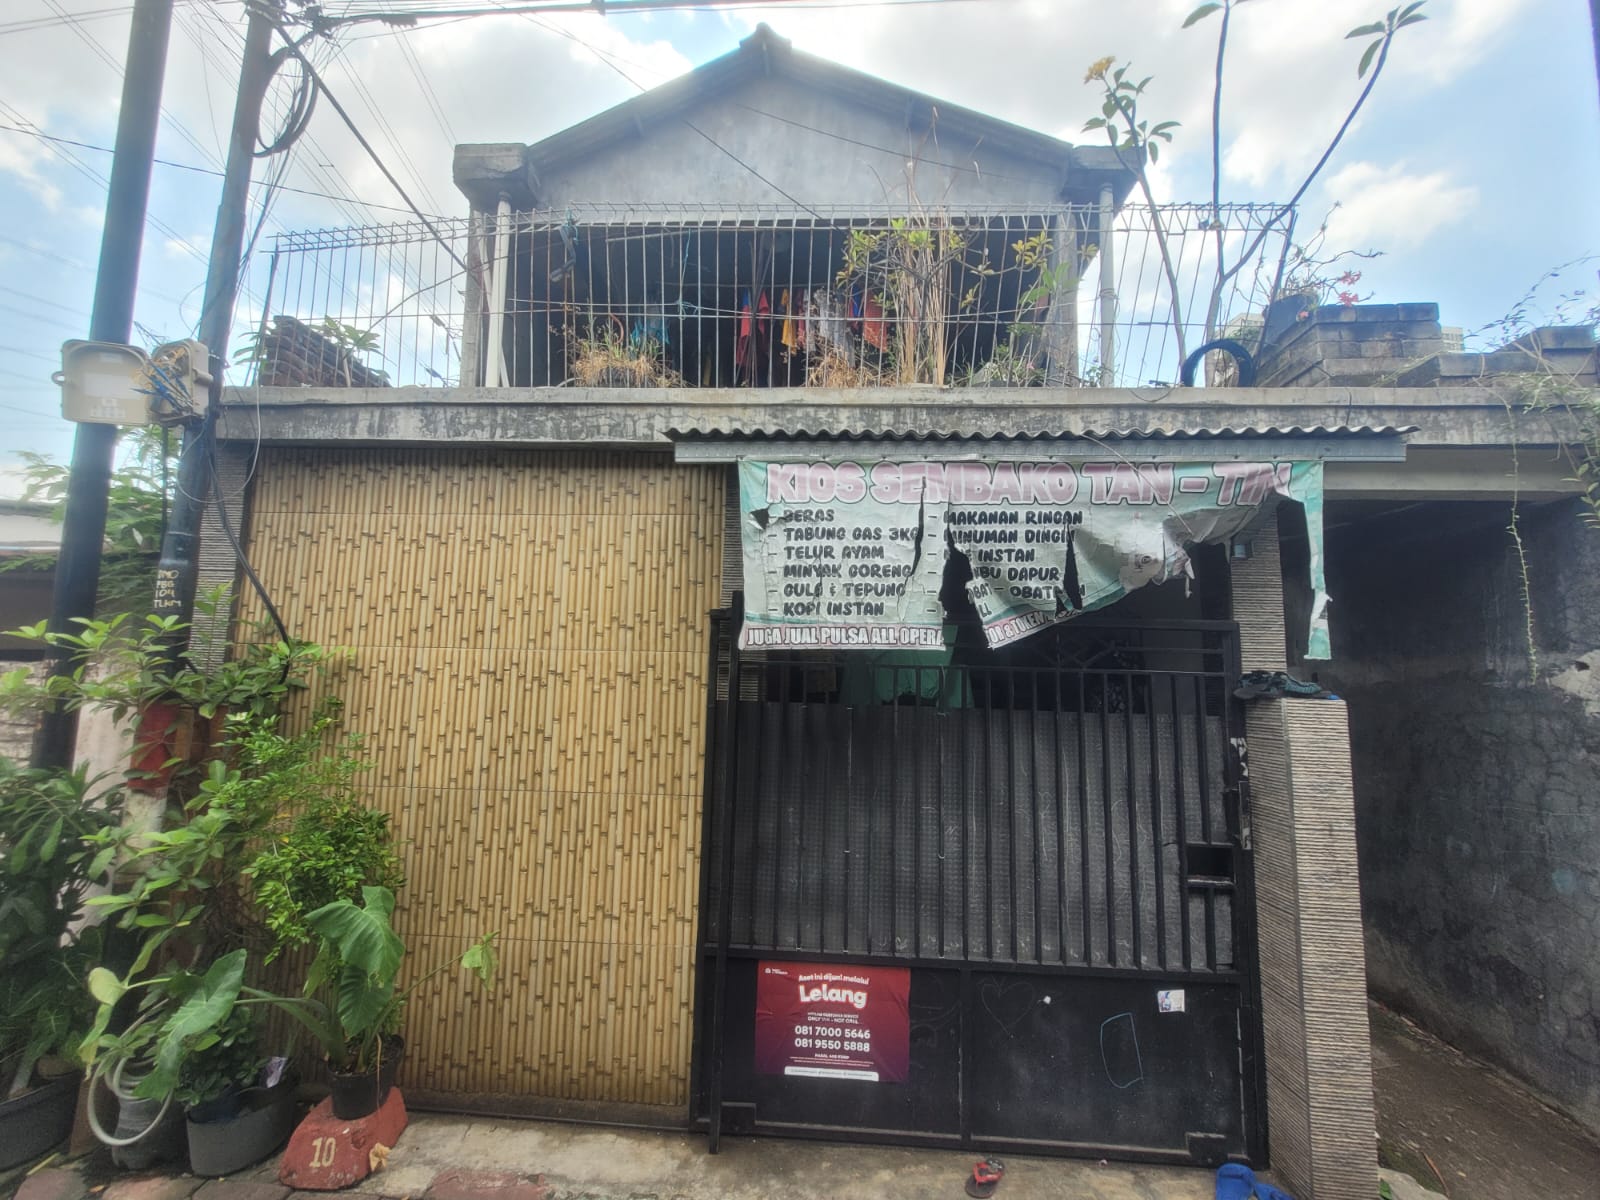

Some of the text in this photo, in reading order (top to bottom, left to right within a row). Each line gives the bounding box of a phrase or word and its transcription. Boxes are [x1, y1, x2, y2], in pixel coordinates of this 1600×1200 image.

[767, 462, 867, 504] KIOS
[870, 462, 1078, 504] SEMBAKO
[1081, 462, 1175, 504] TAN
[1025, 511, 1083, 525] RINGAN
[784, 527, 846, 541] TABUNG
[852, 527, 882, 541] GAS
[784, 546, 885, 560] TELUR AYAM
[978, 549, 1035, 563] INSTAN
[784, 564, 912, 578] MINYAK GORENG
[1007, 567, 1060, 581] DAPUR
[843, 583, 906, 597] TEPUNG
[783, 602, 885, 616] KOPI INSTAN
[747, 628, 783, 645] JUGA
[784, 628, 819, 645] JUAL
[821, 628, 870, 645] PULSA
[869, 628, 897, 645] ALL
[800, 983, 868, 1009] Lelang
[795, 1025, 871, 1040] 081 7000 5646
[795, 1037, 871, 1053] 081 9550 5888
[309, 1137, 336, 1168] 10
